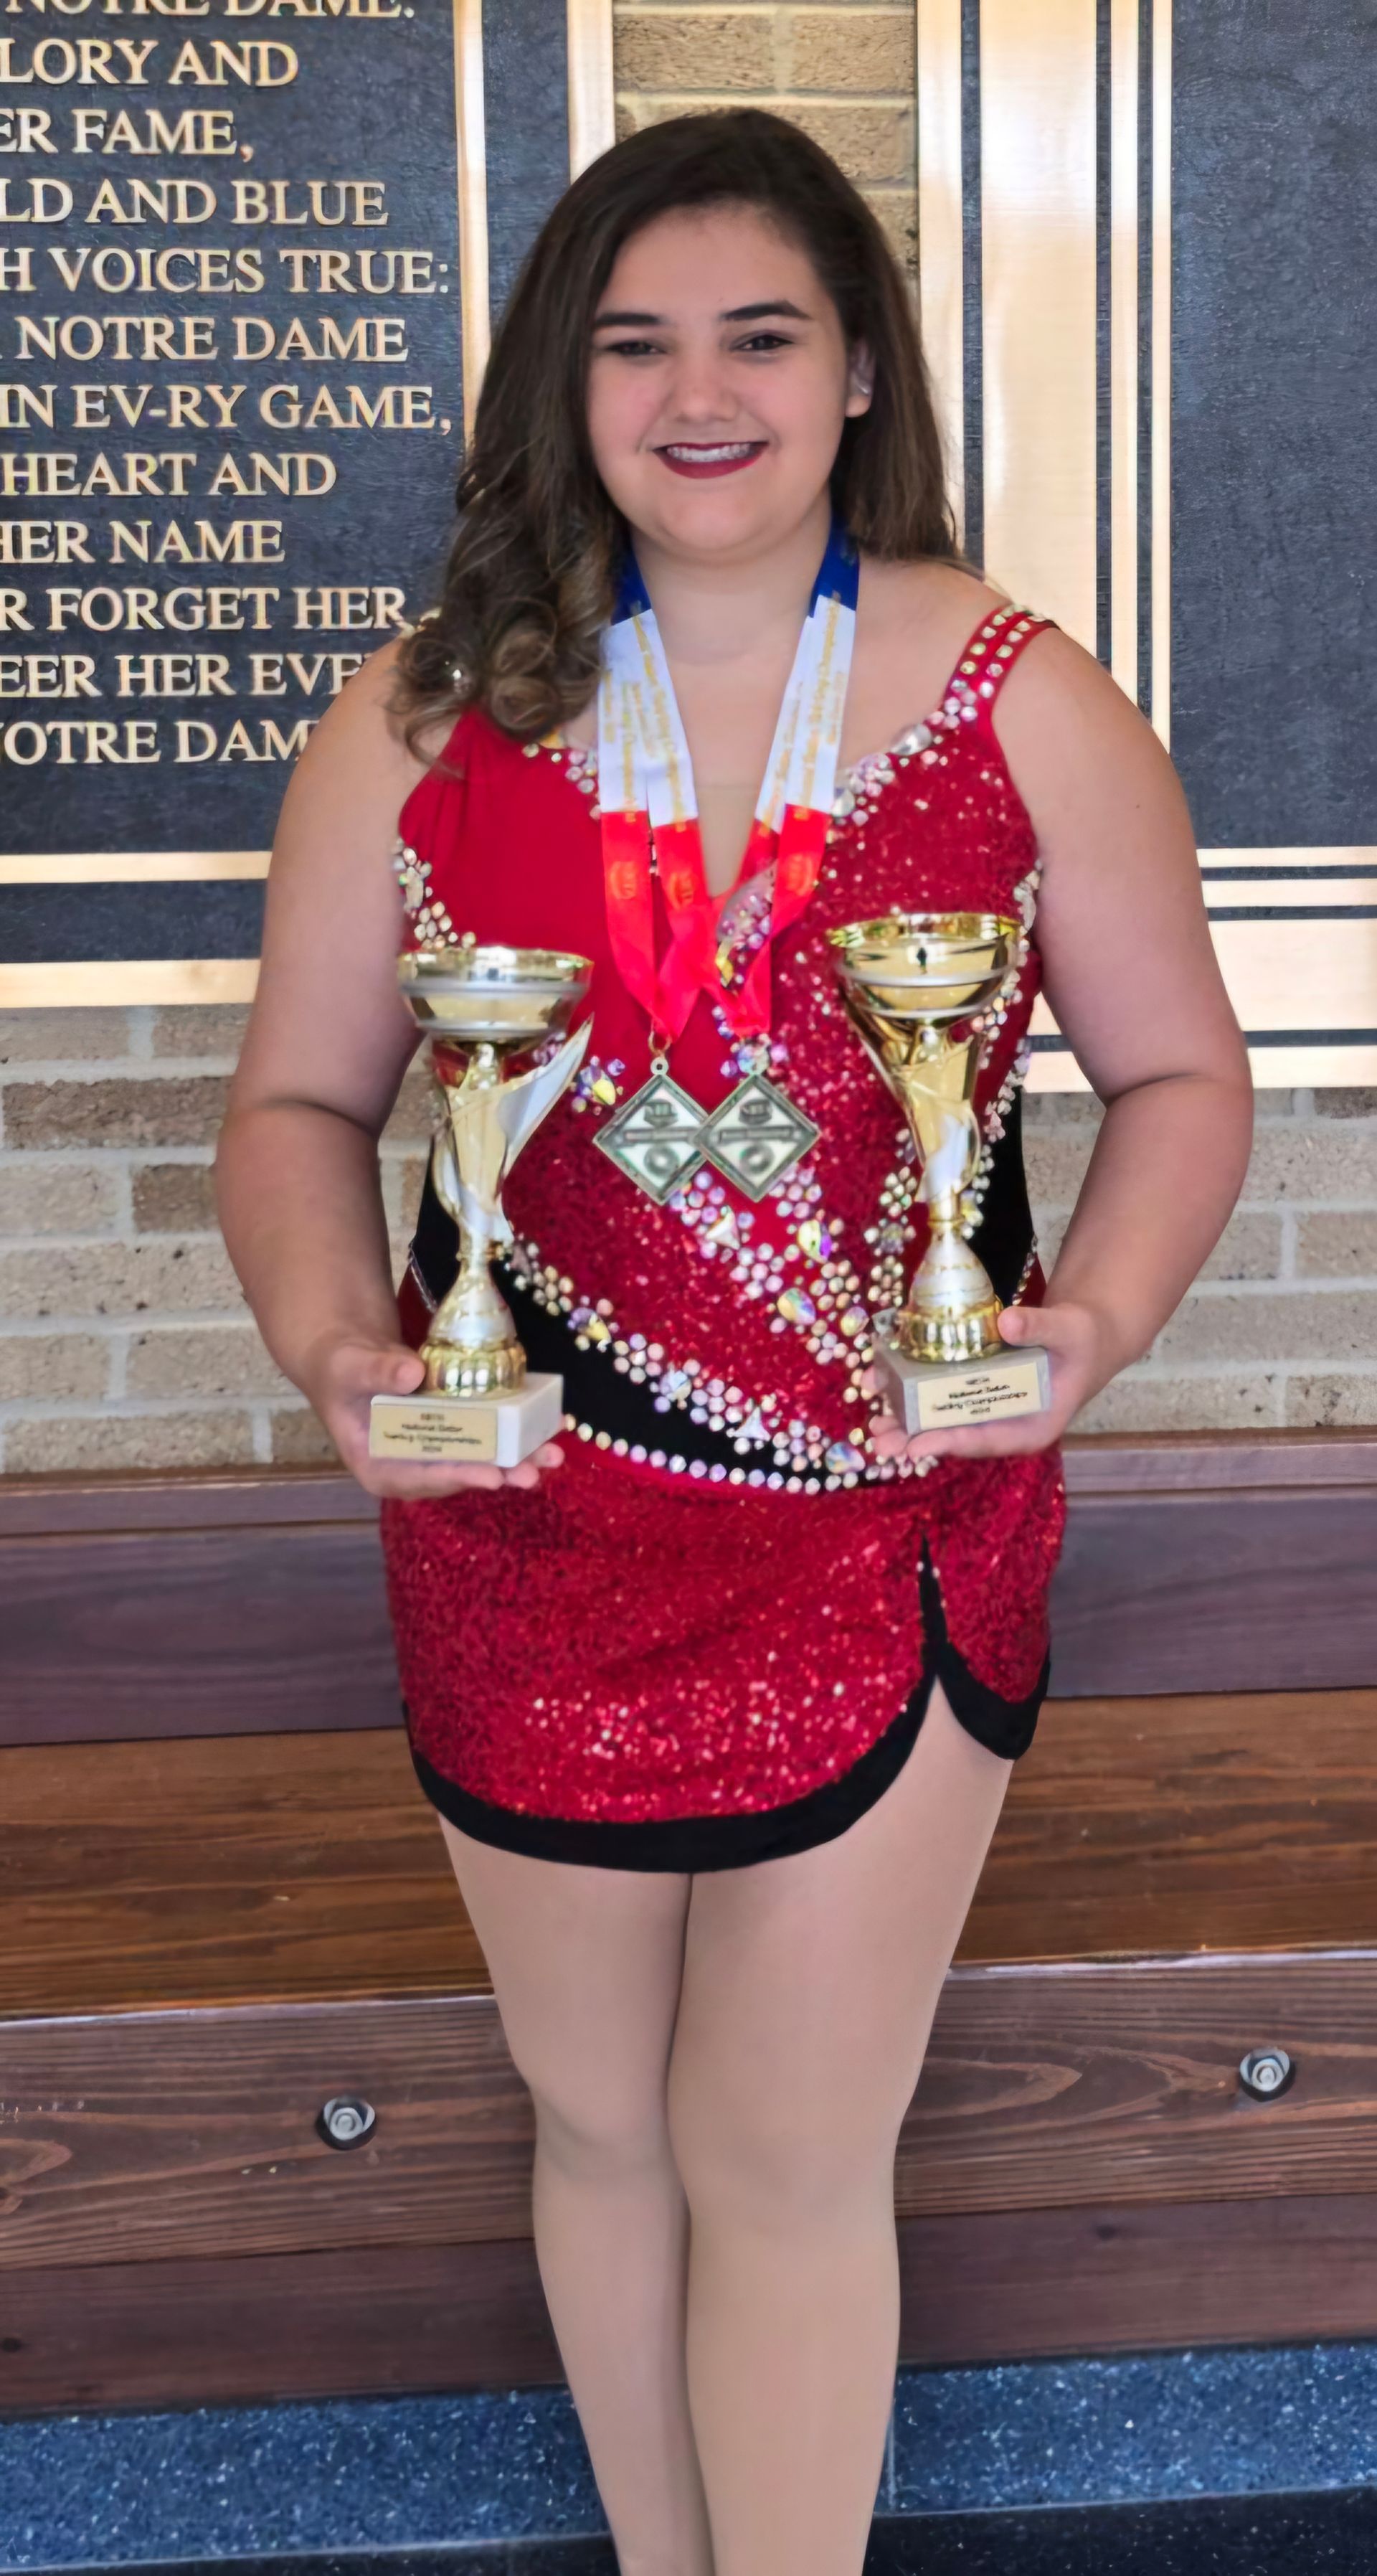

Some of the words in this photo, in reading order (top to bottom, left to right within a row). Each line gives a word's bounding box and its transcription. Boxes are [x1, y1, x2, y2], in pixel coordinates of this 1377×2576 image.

[0, 37, 158, 84] LORY
[168, 40, 298, 86] AND
[72, 108, 254, 162] FAME,
[0, 178, 73, 222] LD
[85, 179, 217, 223] AND
[231, 180, 389, 225] BLUE
[0, 247, 35, 291] H
[47, 247, 265, 293] VOICES
[279, 249, 449, 294] TRUE:
[15, 315, 219, 361] NOTRE
[232, 316, 409, 362] DAME
[0, 384, 58, 428] IN
[70, 384, 247, 428] EV-RY
[260, 384, 451, 435] GAME,
[0, 452, 197, 496] HEART
[208, 452, 336, 496] AND
[109, 520, 285, 563] NAME
[0, 588, 35, 631] R
[45, 587, 280, 631] FORGET
[293, 587, 414, 630] HER
[0, 654, 102, 698] EER
[114, 654, 236, 697] HER
[249, 654, 372, 698] EVE
[0, 721, 161, 765] OTRE
